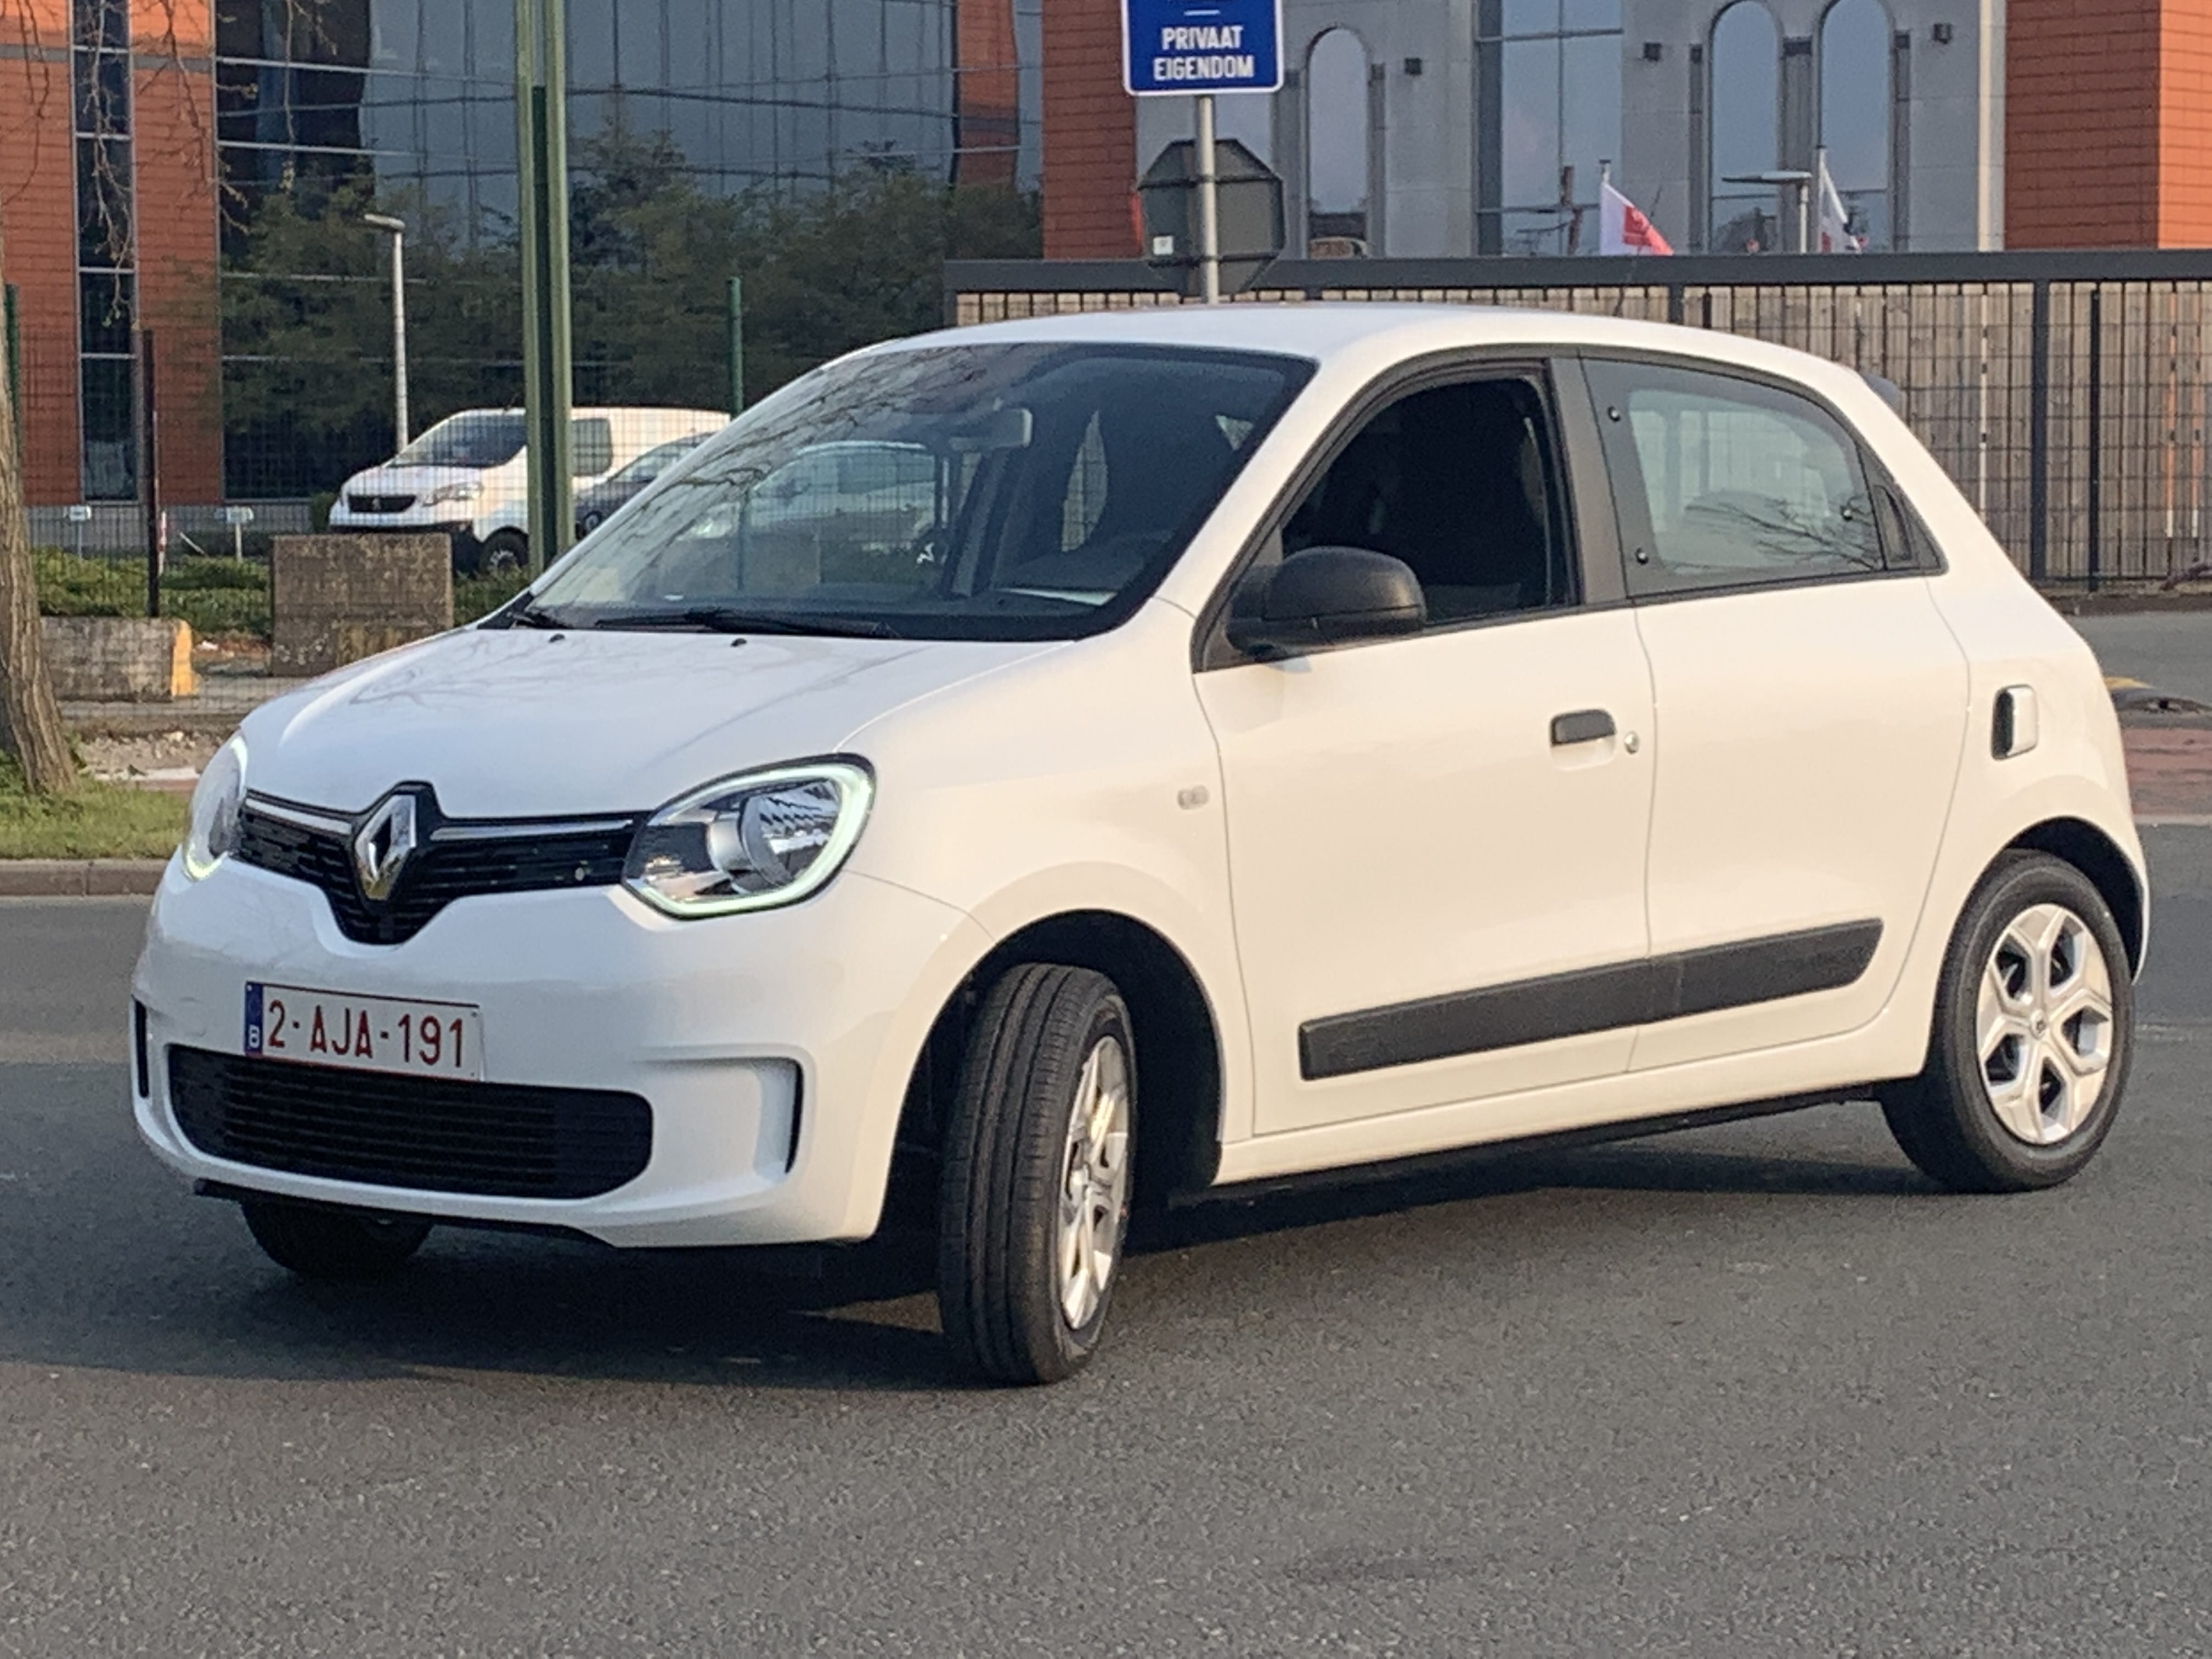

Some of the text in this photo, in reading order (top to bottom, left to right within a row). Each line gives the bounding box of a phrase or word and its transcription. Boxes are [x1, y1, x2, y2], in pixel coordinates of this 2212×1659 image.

[1161, 25, 1244, 50] PRIVAAT
[1154, 55, 1255, 81] EIGENDOM
[250, 1024, 259, 1048] B
[268, 999, 463, 1068] 2-AJA-191
